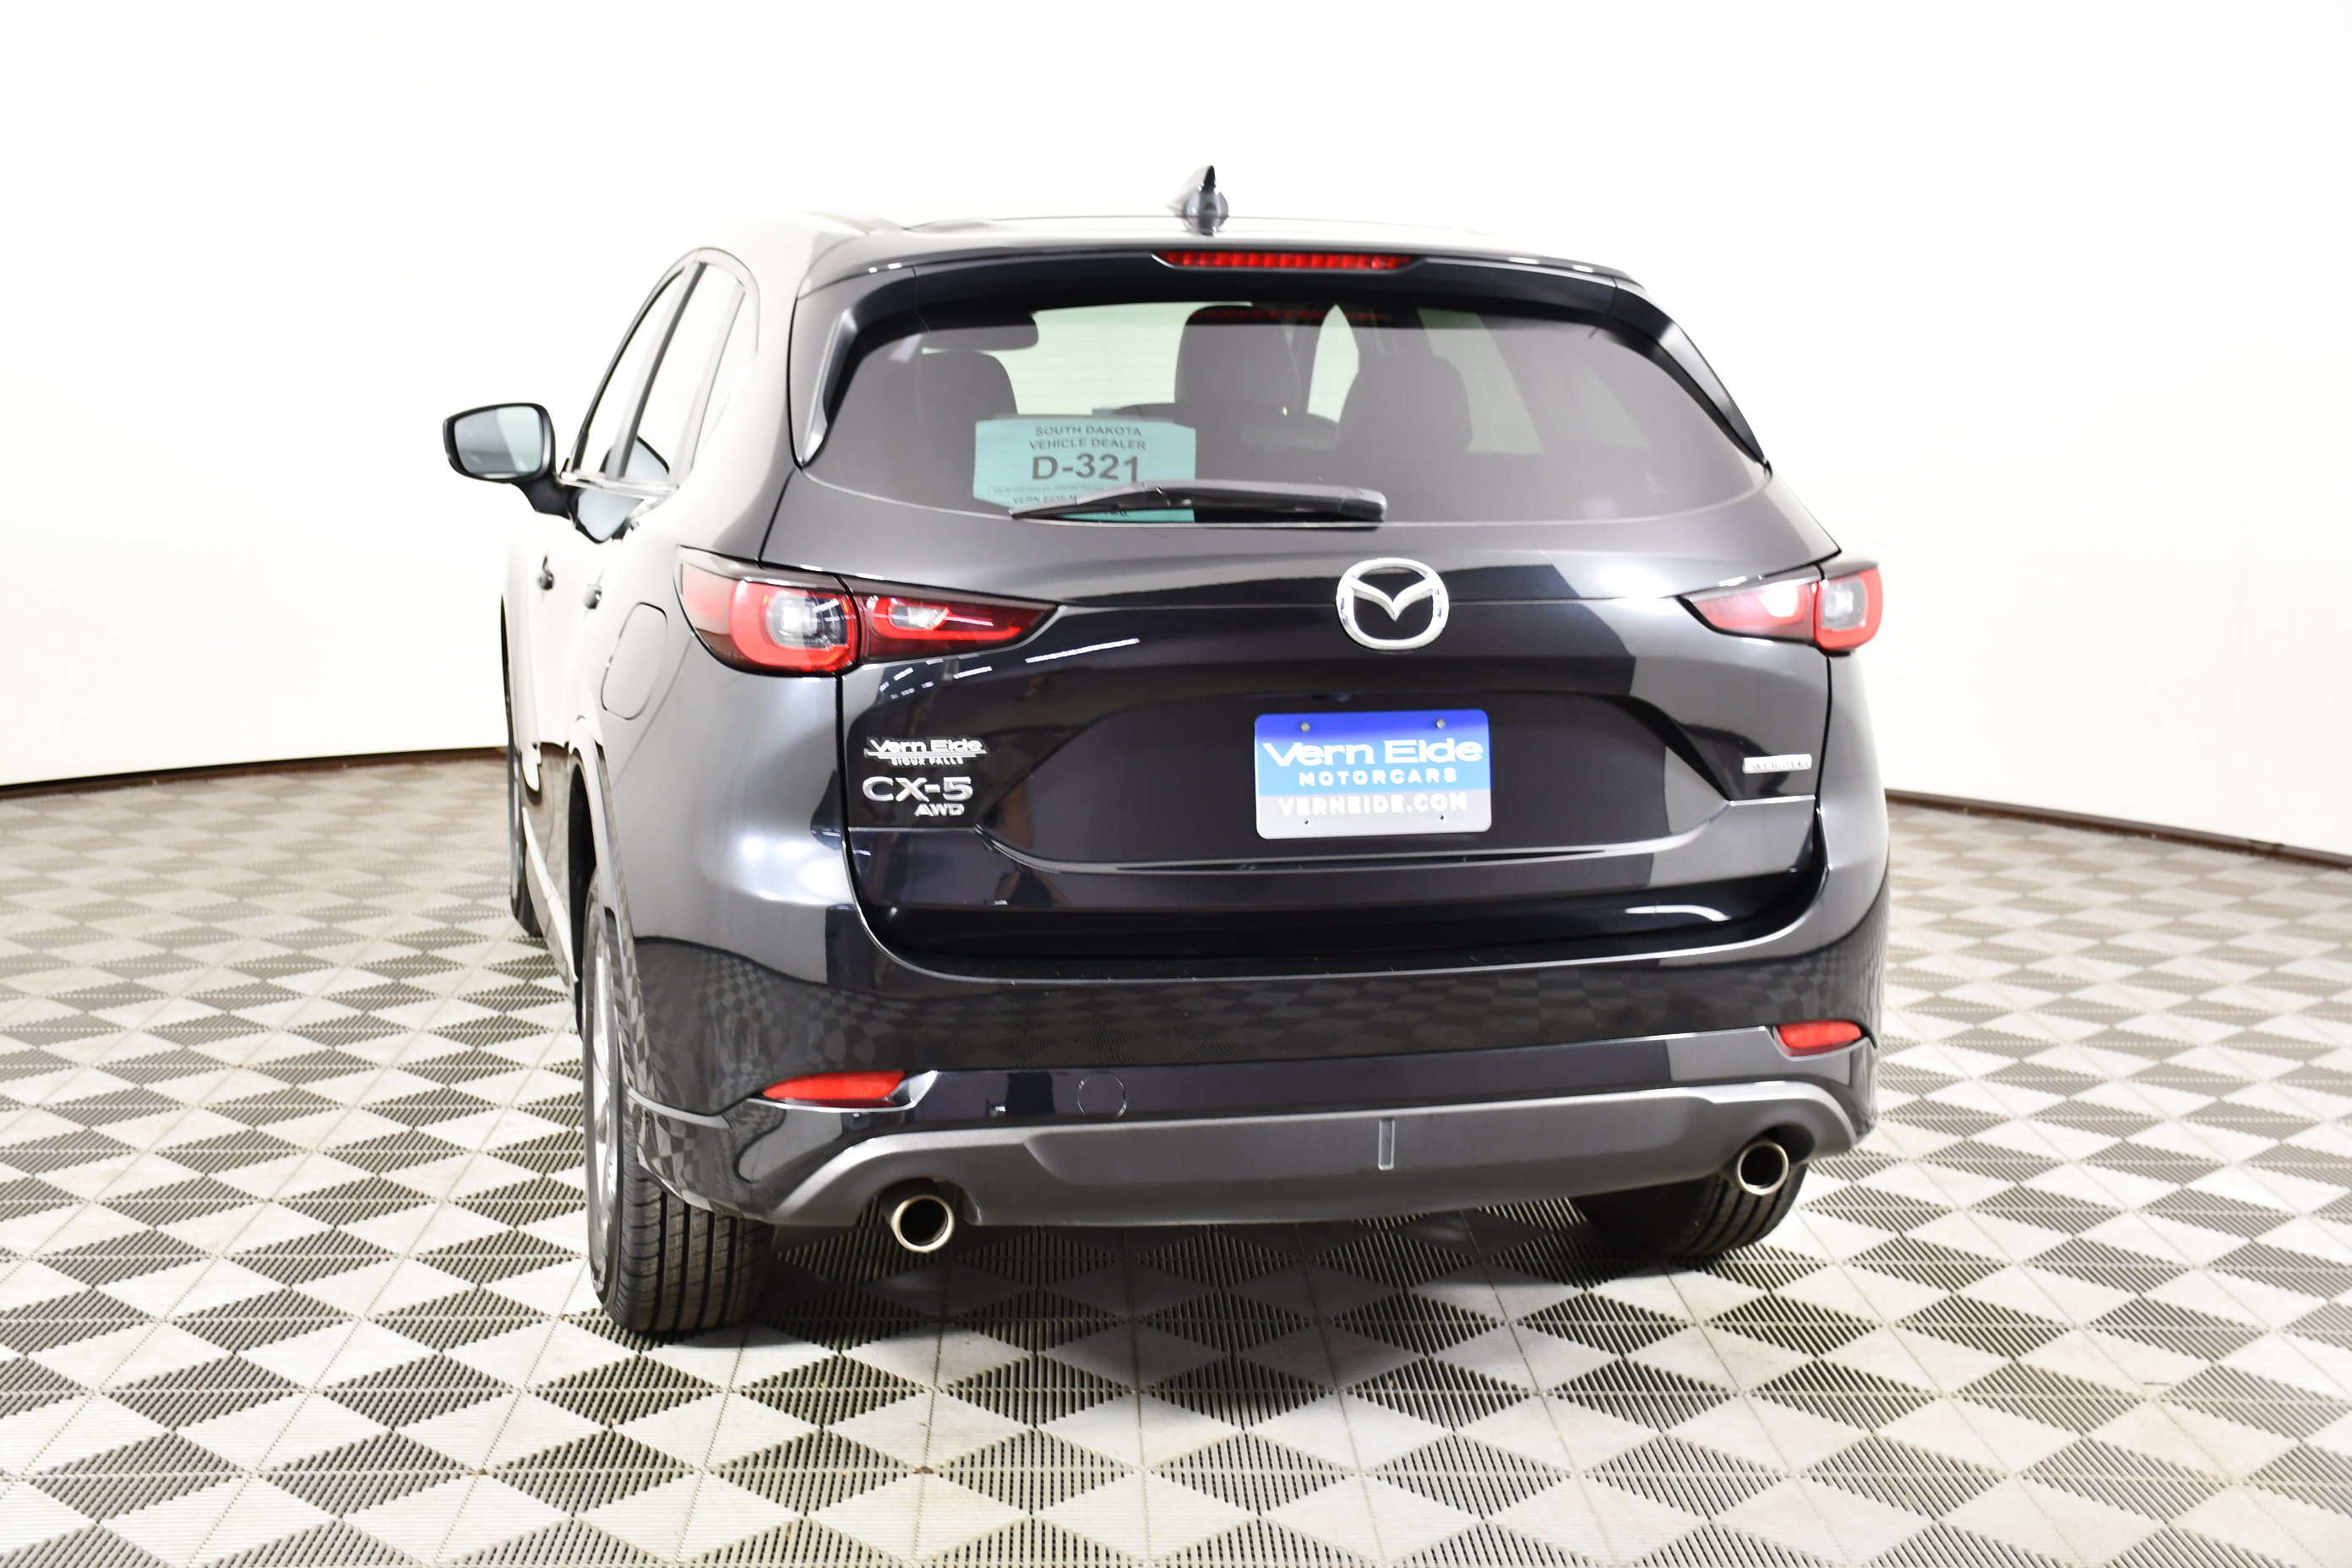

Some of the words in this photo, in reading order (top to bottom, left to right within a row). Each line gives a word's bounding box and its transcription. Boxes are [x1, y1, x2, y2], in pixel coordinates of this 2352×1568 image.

[1036, 426, 1082, 437] SOUTH
[1086, 426, 1142, 437] DAKOTA
[1030, 438, 1087, 450] VEHICLE
[1091, 438, 1146, 450] DEALER
[1032, 453, 1138, 482] D-321
[869, 739, 928, 753] Vern
[891, 757, 926, 766] SIOUX
[929, 756, 964, 765] FALLS
[1262, 743, 1375, 766] Vern
[1299, 768, 1457, 787] MOTORCARS
[862, 776, 973, 802] CX-5
[914, 803, 965, 817] AWD
[1278, 792, 1467, 817] VERNEIDE.COM
